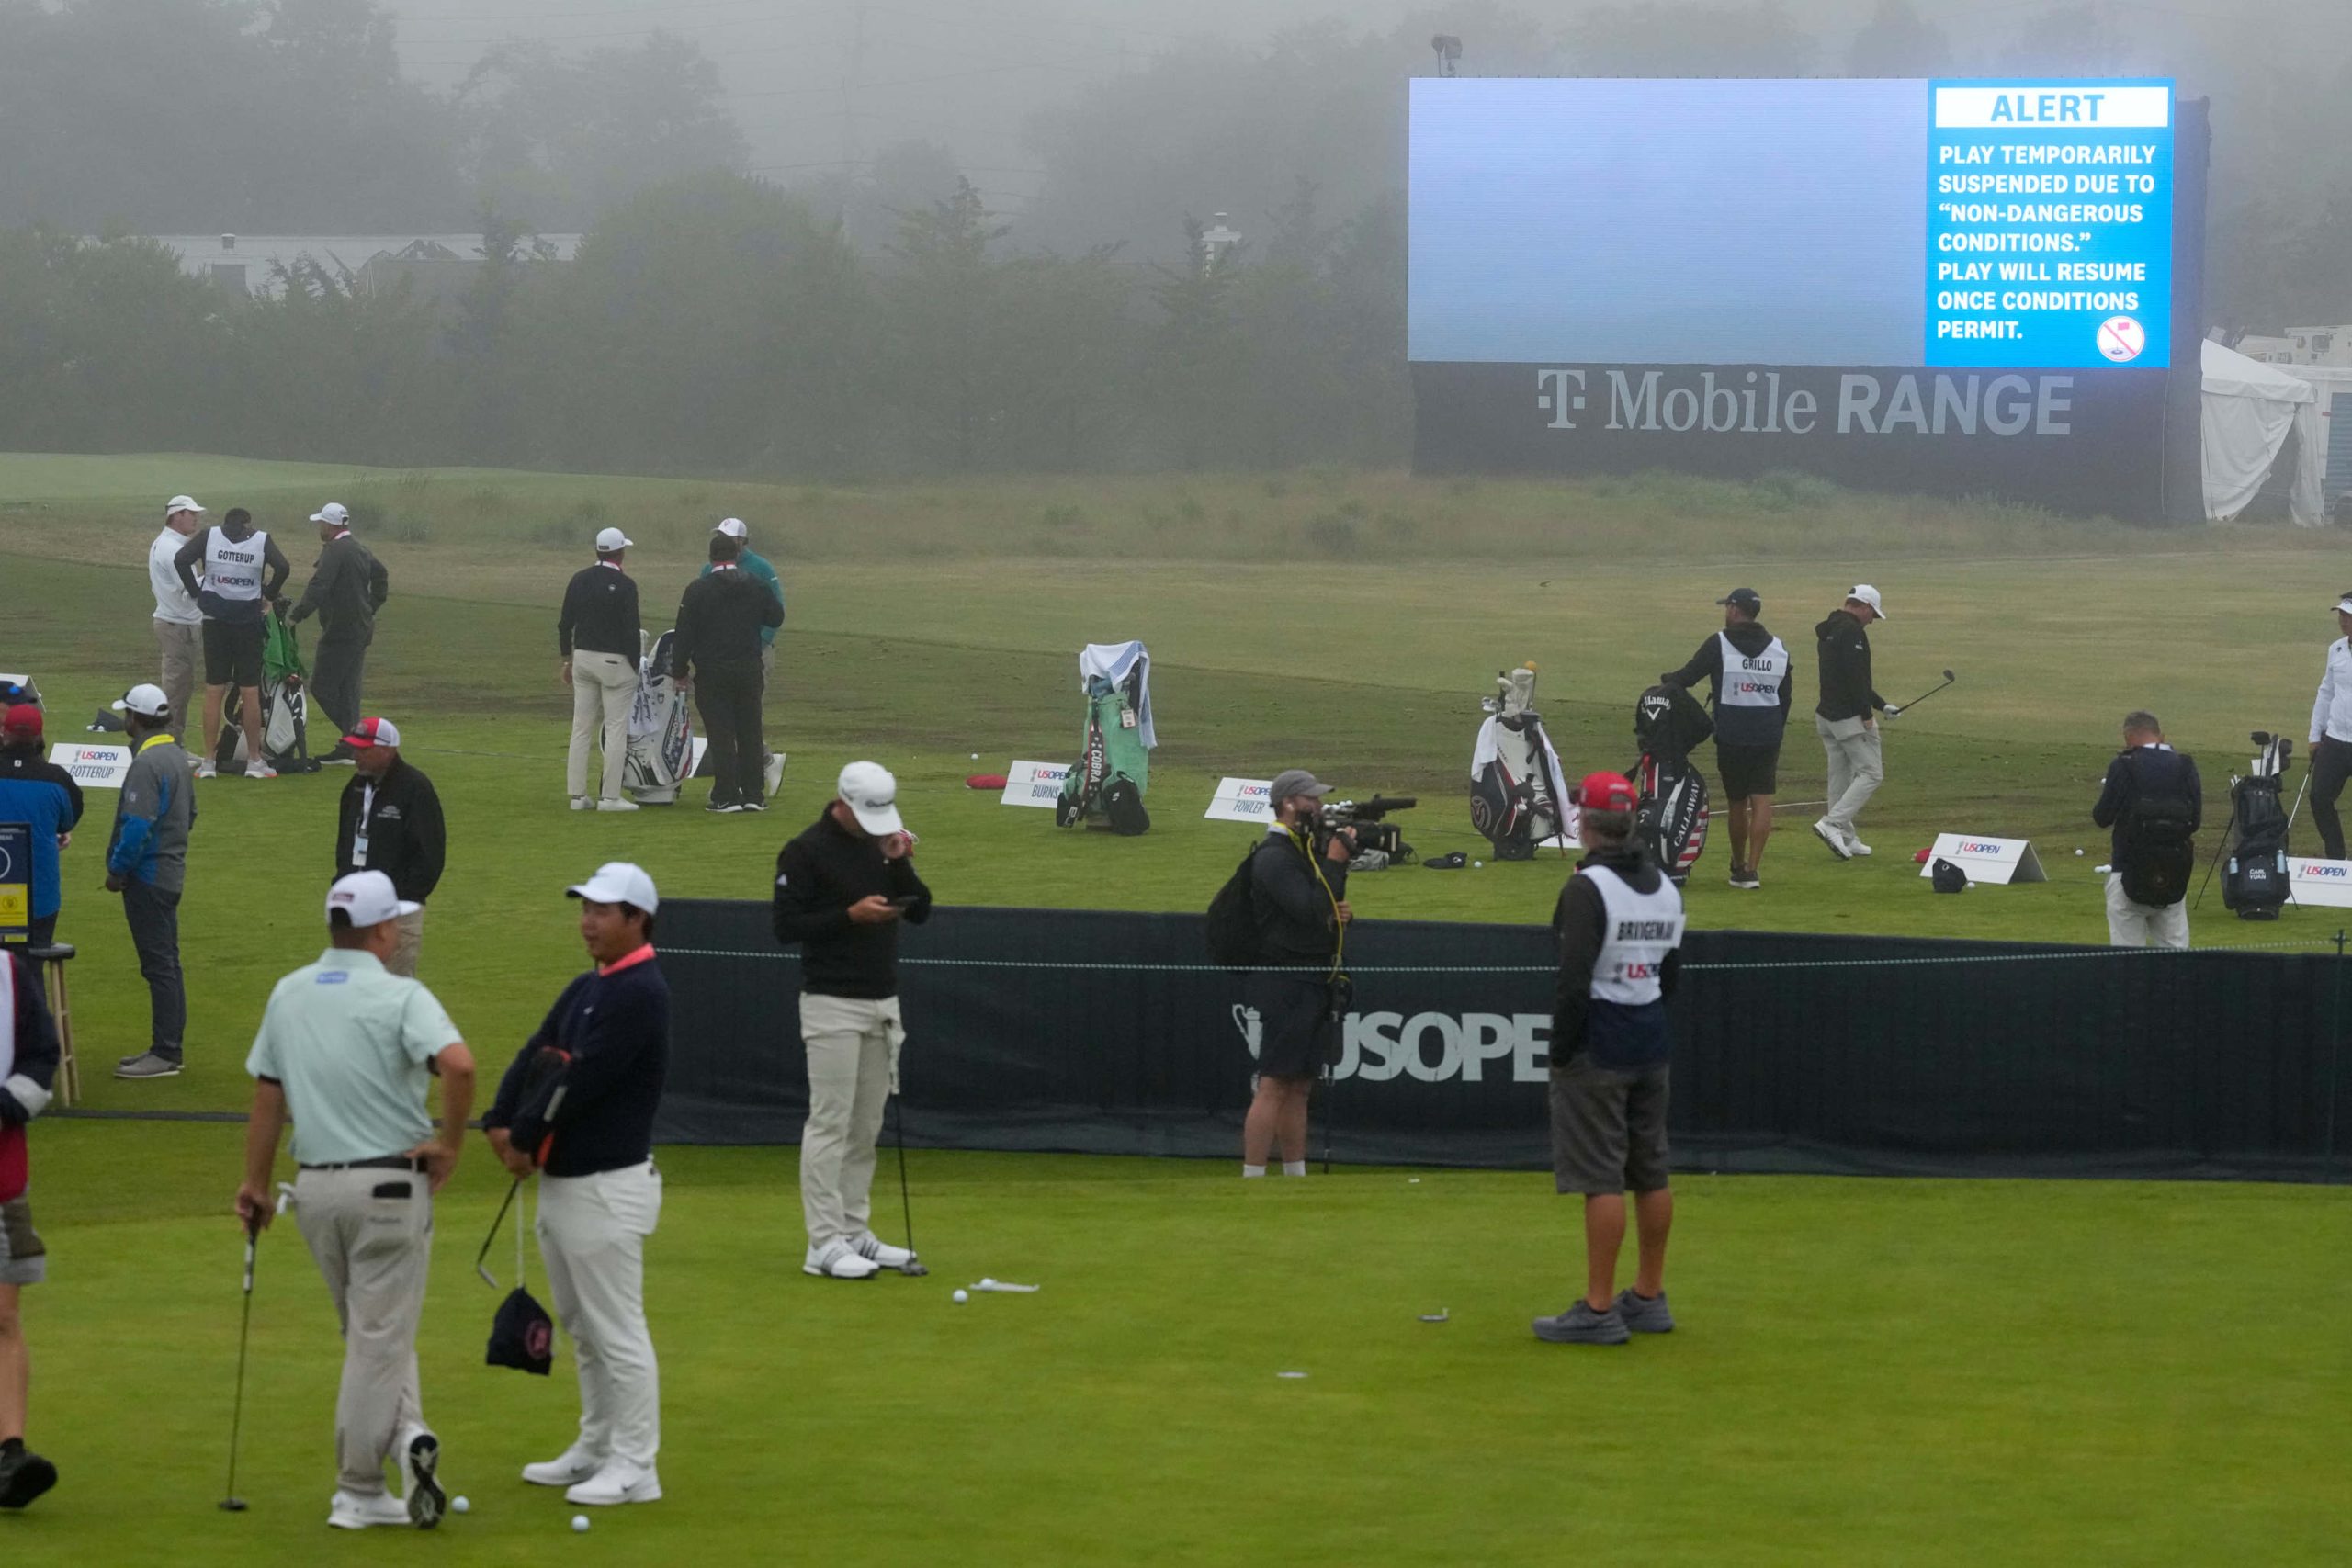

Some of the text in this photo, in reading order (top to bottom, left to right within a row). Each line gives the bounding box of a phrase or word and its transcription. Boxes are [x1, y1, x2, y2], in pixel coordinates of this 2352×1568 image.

[1990, 94, 2105, 122] ALERT
[1939, 145, 2156, 164] PLAY TEMPORARILY
[1939, 175, 2155, 194] SUSPENDED DUE TO
[1939, 203, 2143, 223] “NON-DANGEROUS
[1938, 232, 2091, 252] CONDITIONS.”
[1938, 263, 2146, 282] PLAY WILL RESUME
[1937, 291, 2139, 310] ONCE CONDITIONS
[1937, 321, 2023, 339] PERMIT.
[1605, 370, 1817, 434] Mobile
[1838, 374, 2075, 436] RANGE
[218, 550, 255, 564] GOTTERUP
[1742, 659, 1772, 671] GRILLO
[69, 764, 115, 779] GOTTERUP
[1090, 750, 1102, 783] COBRA
[1031, 784, 1059, 799] BURNS
[1233, 799, 1265, 815] FOWLER
[1673, 779, 1700, 847] CALLAWAY
